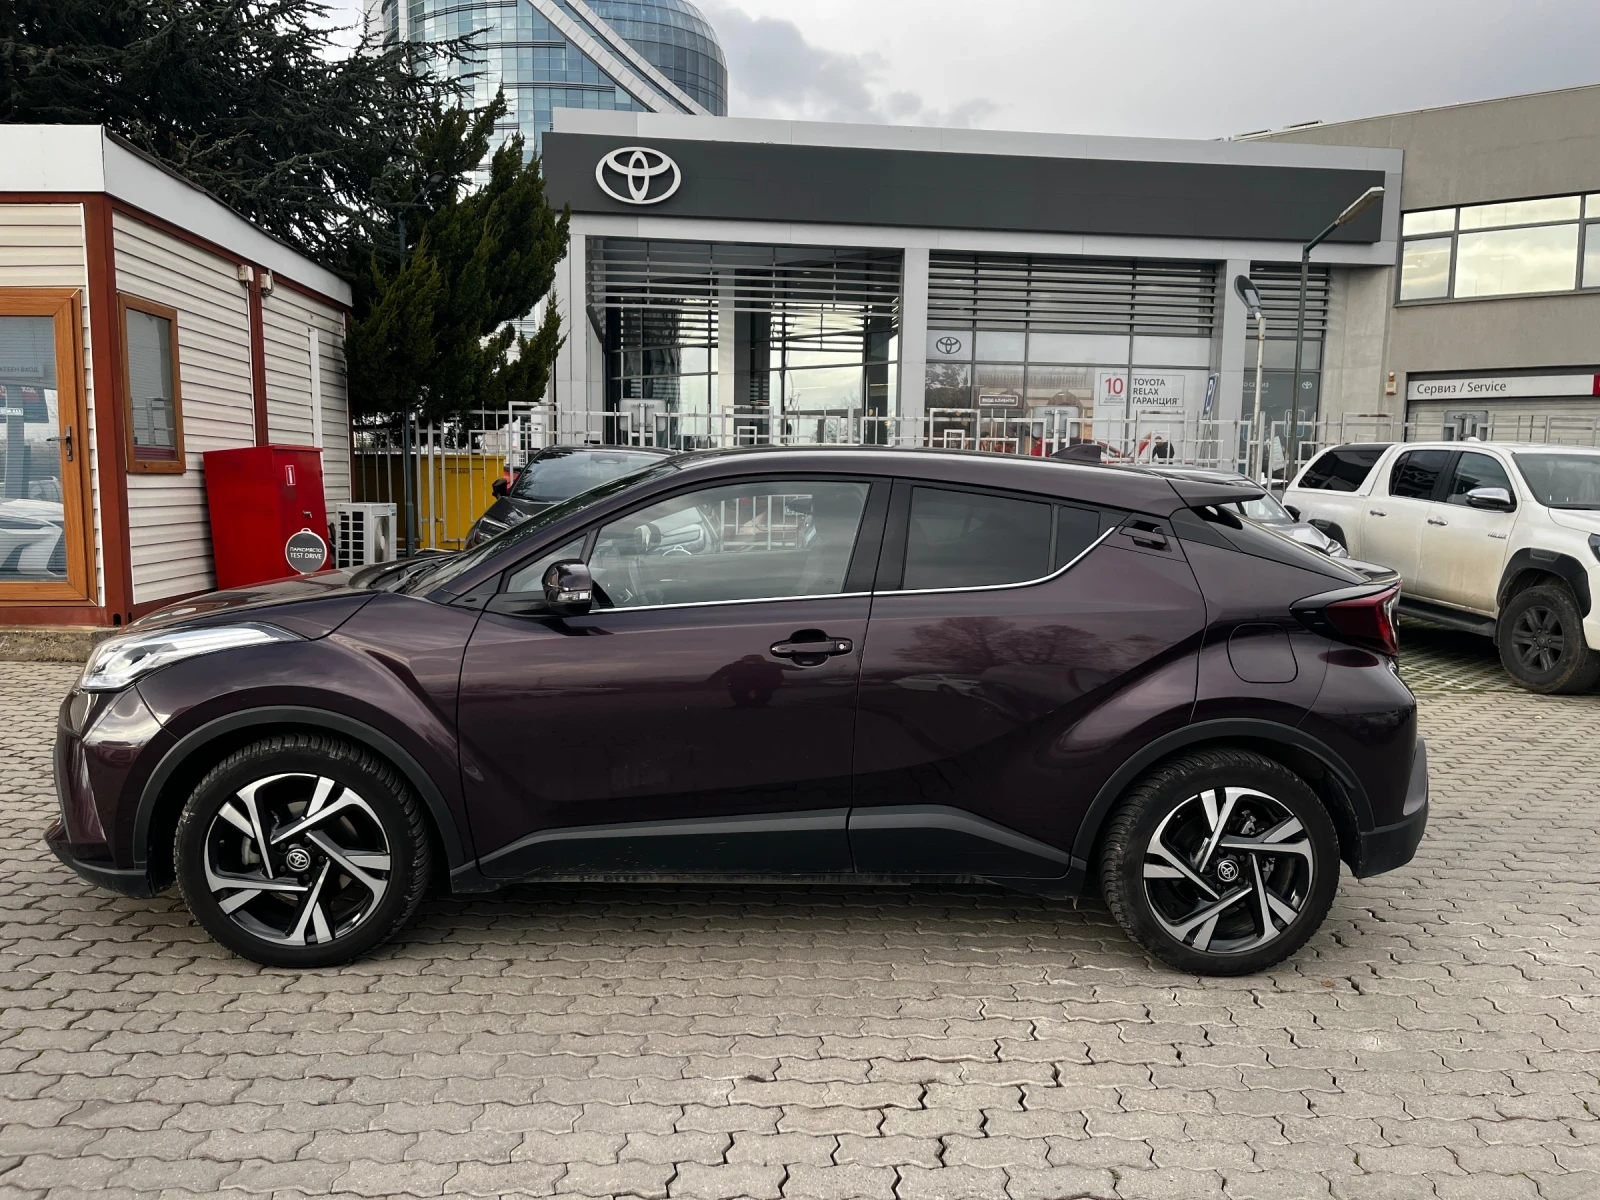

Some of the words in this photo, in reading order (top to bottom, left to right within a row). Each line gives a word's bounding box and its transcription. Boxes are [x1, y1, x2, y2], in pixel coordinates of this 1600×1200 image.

[20, 366, 39, 374] ВХОД
[1105, 377, 1124, 395] 10
[1133, 378, 1166, 386] TOYOTA
[1132, 387, 1159, 396] RELAX
[1416, 383, 1457, 396] Сервиз
[1459, 382, 1465, 393] /
[1467, 381, 1507, 393] Service
[304, 552, 322, 560] DRIVE
